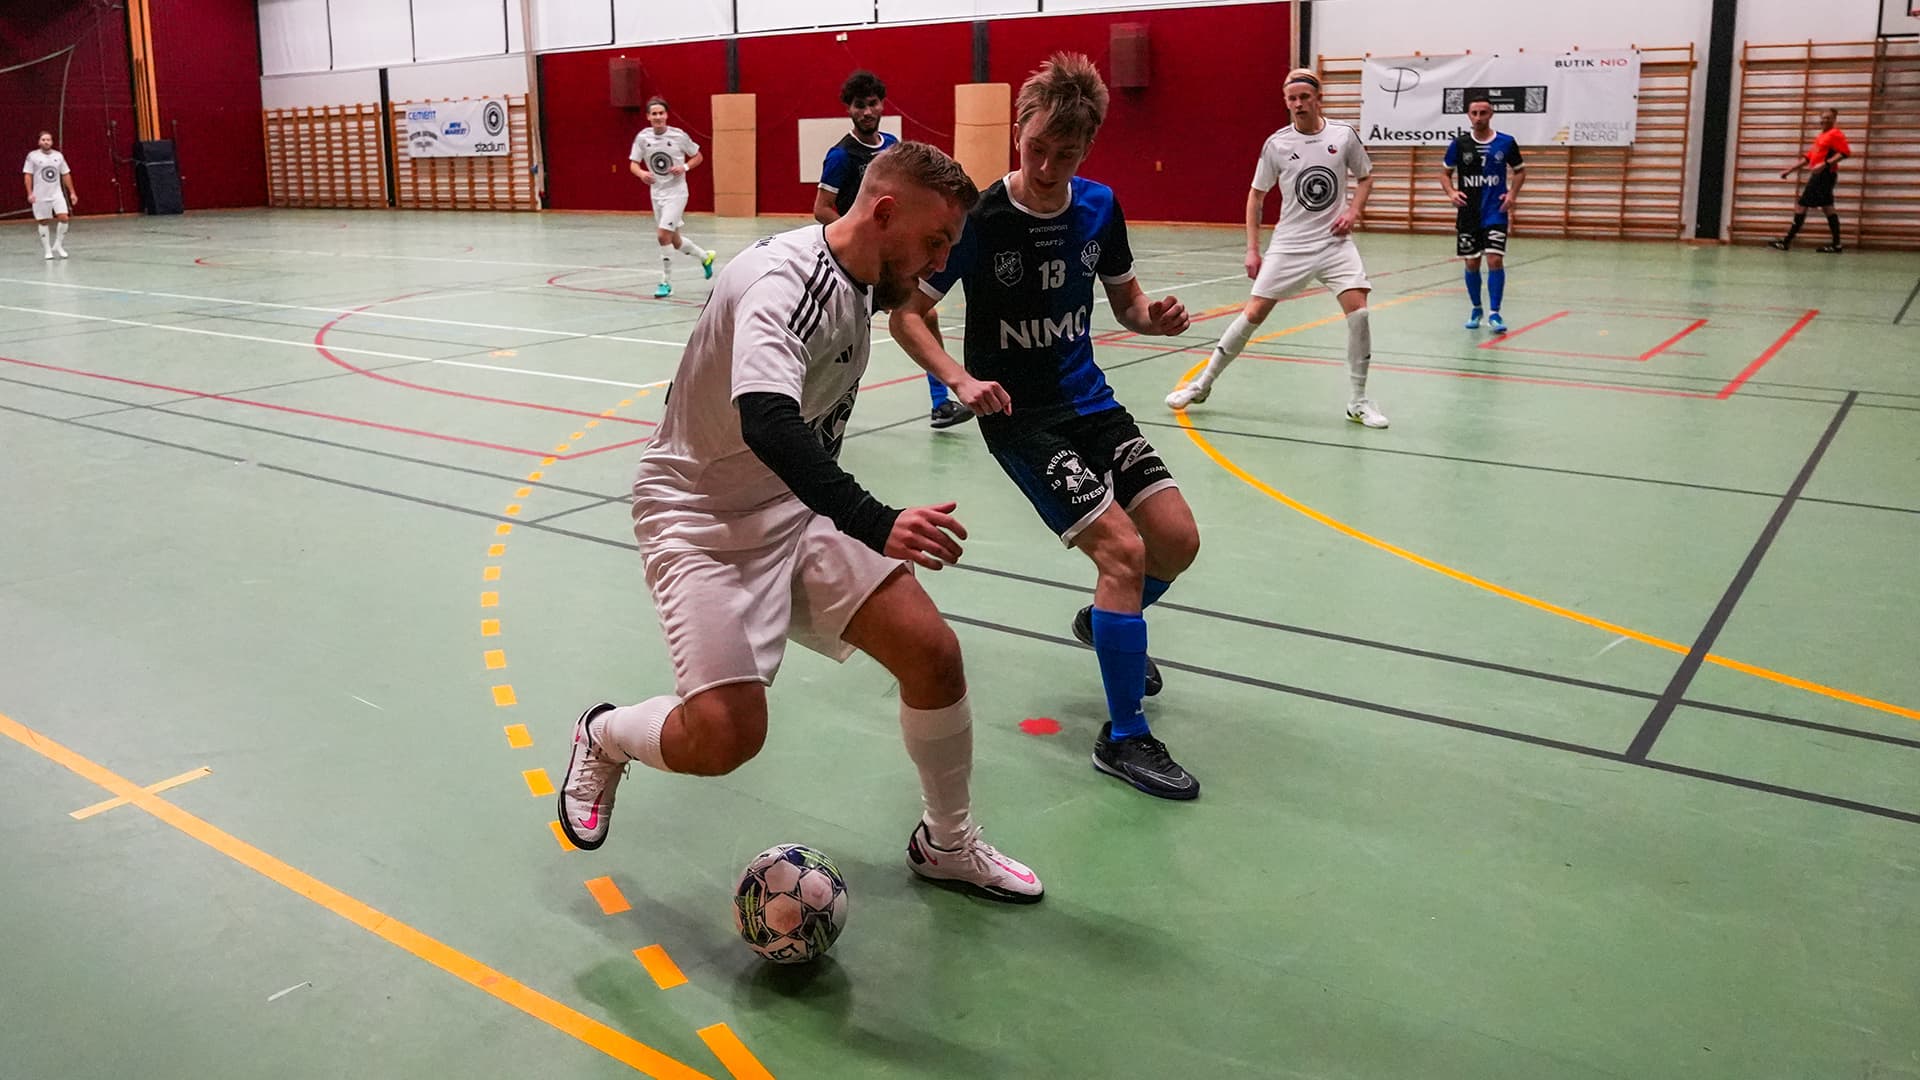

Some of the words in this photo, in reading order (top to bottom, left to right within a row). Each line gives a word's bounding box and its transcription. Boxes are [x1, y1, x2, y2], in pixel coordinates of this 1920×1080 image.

[1554, 59, 1594, 68] BUTIK
[1600, 58, 1628, 67] NIO
[1574, 130, 1618, 141] ENERGI
[1463, 174, 1500, 188] NIMO
[1038, 259, 1066, 290] 13
[1051, 479, 1062, 491] 19
